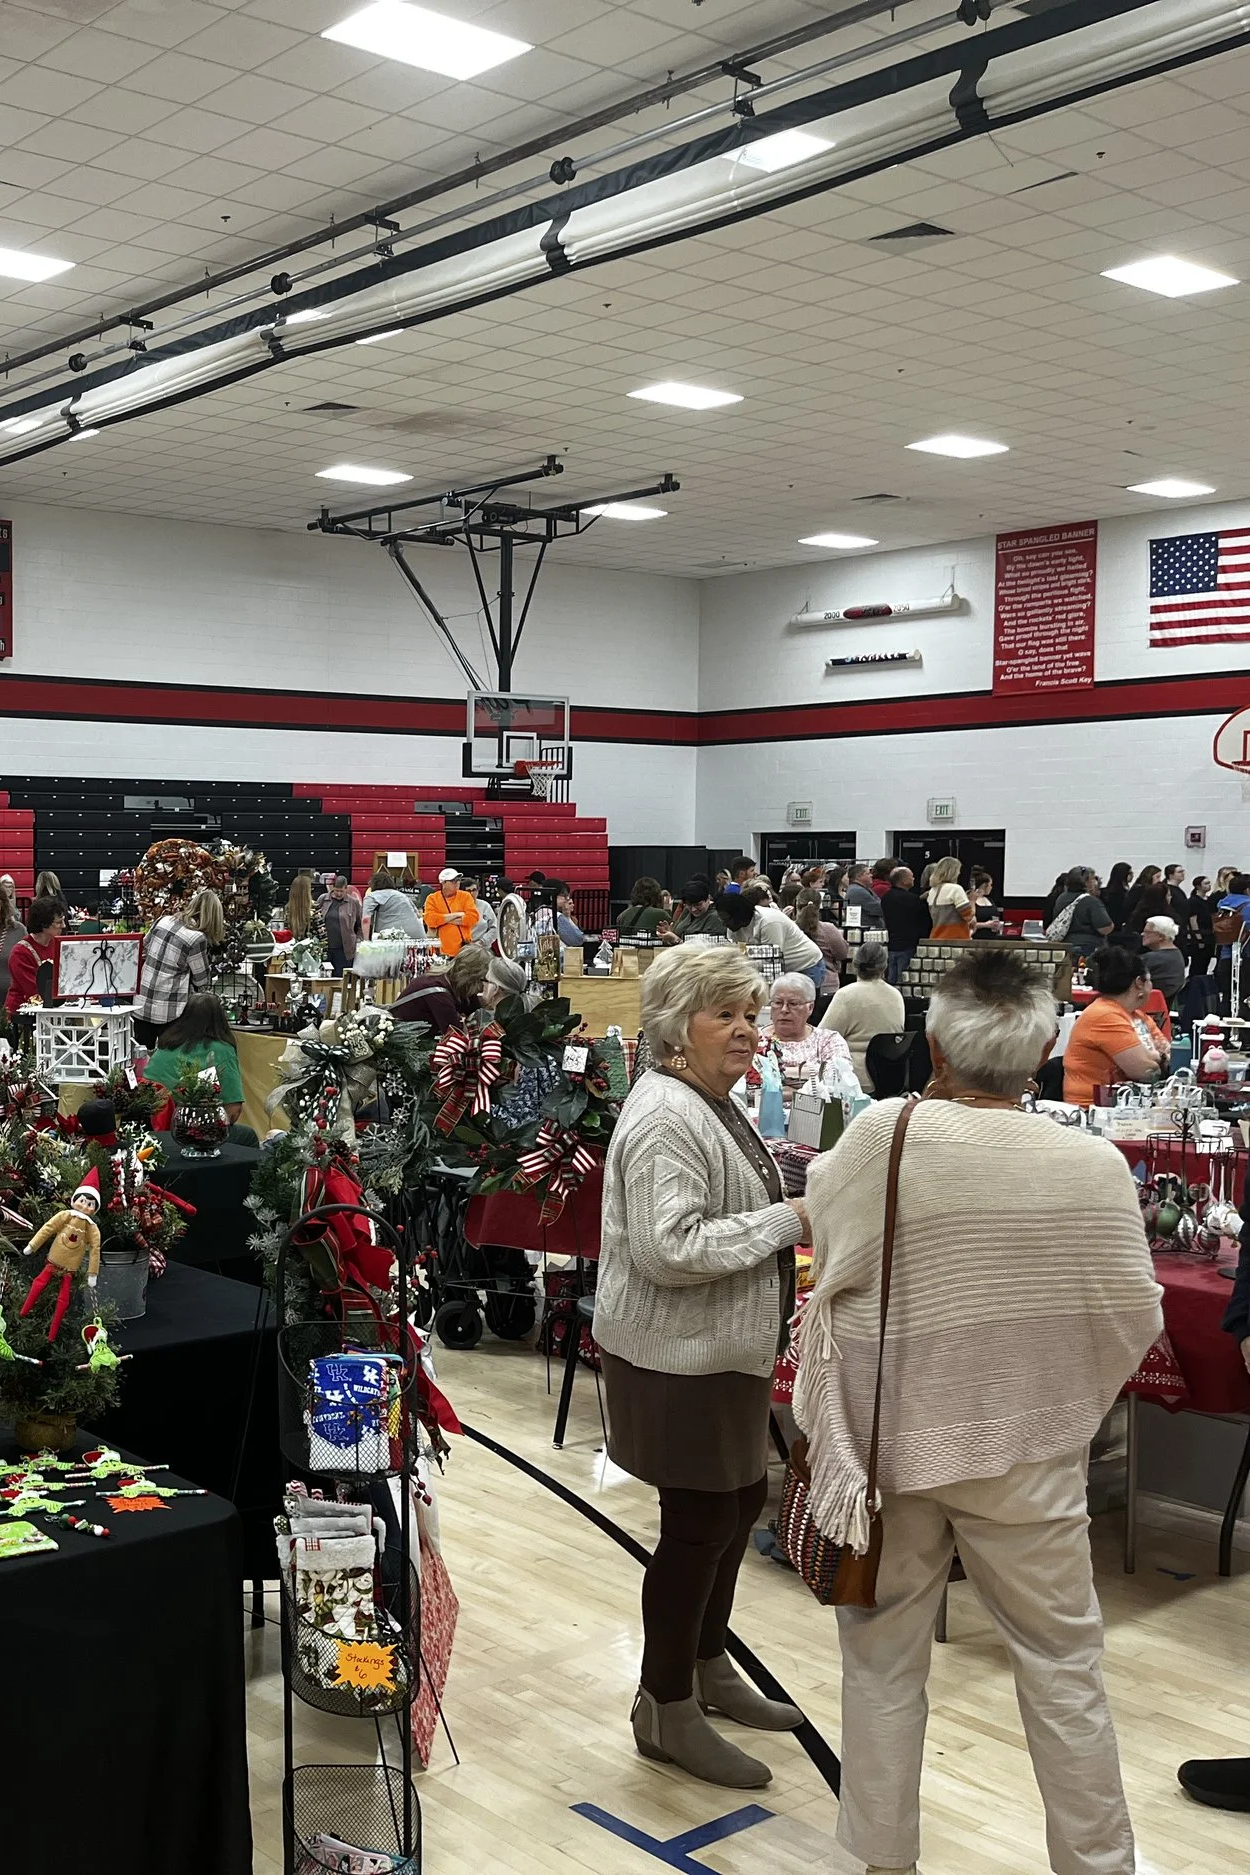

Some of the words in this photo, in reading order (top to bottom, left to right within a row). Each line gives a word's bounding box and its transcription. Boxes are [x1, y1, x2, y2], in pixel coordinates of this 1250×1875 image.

[998, 541, 1016, 549] STAR
[1019, 534, 1060, 546] SPANGLED
[1062, 528, 1095, 539] BANNER
[824, 612, 840, 620] 2000
[795, 808, 808, 819] EXIT
[935, 804, 949, 816] EXIT
[924, 851, 930, 859] 5
[345, 1653, 384, 1670] Stockings
